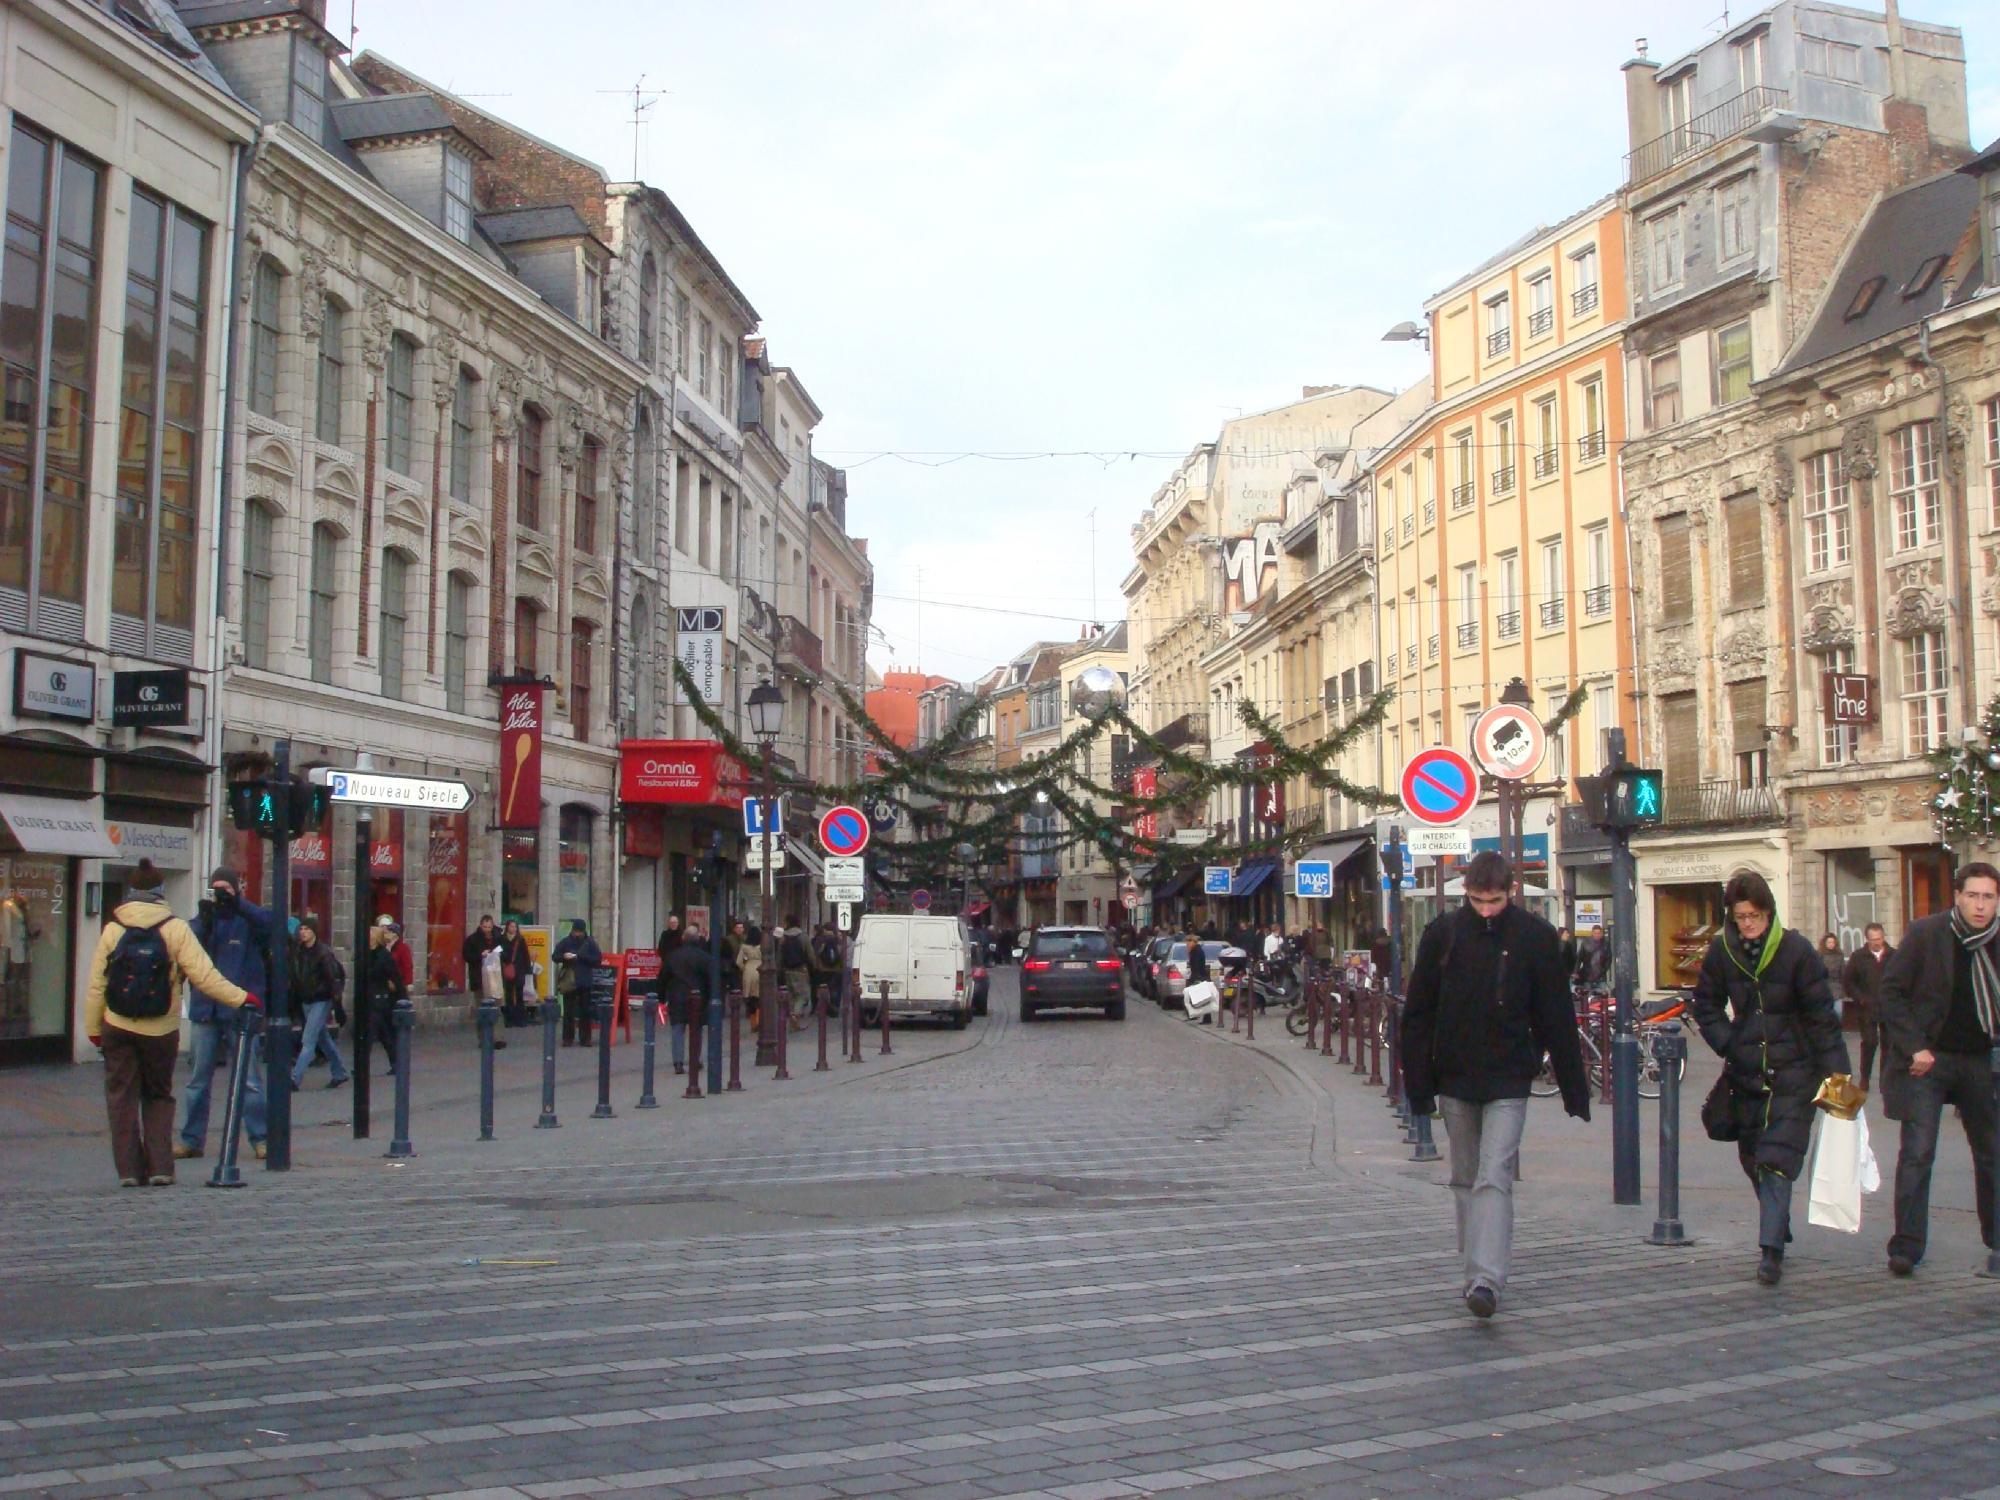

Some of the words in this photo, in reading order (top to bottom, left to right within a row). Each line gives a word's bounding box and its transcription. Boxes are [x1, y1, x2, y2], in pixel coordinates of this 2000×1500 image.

[680, 609, 722, 631] MD
[704, 638, 714, 699] composable
[28, 691, 59, 705] OLIVER
[60, 695, 87, 709] GRANT
[115, 704, 149, 713] OLIVER
[151, 703, 184, 712] GRANT
[507, 692, 536, 711] Alice
[644, 760, 696, 775] Omnia
[351, 781, 410, 800] Nouveau
[13, 816, 56, 830] OLIVER
[57, 820, 97, 833] GRANT
[1422, 832, 1456, 841] INTERDIT
[1300, 873, 1329, 884] TAXIS
